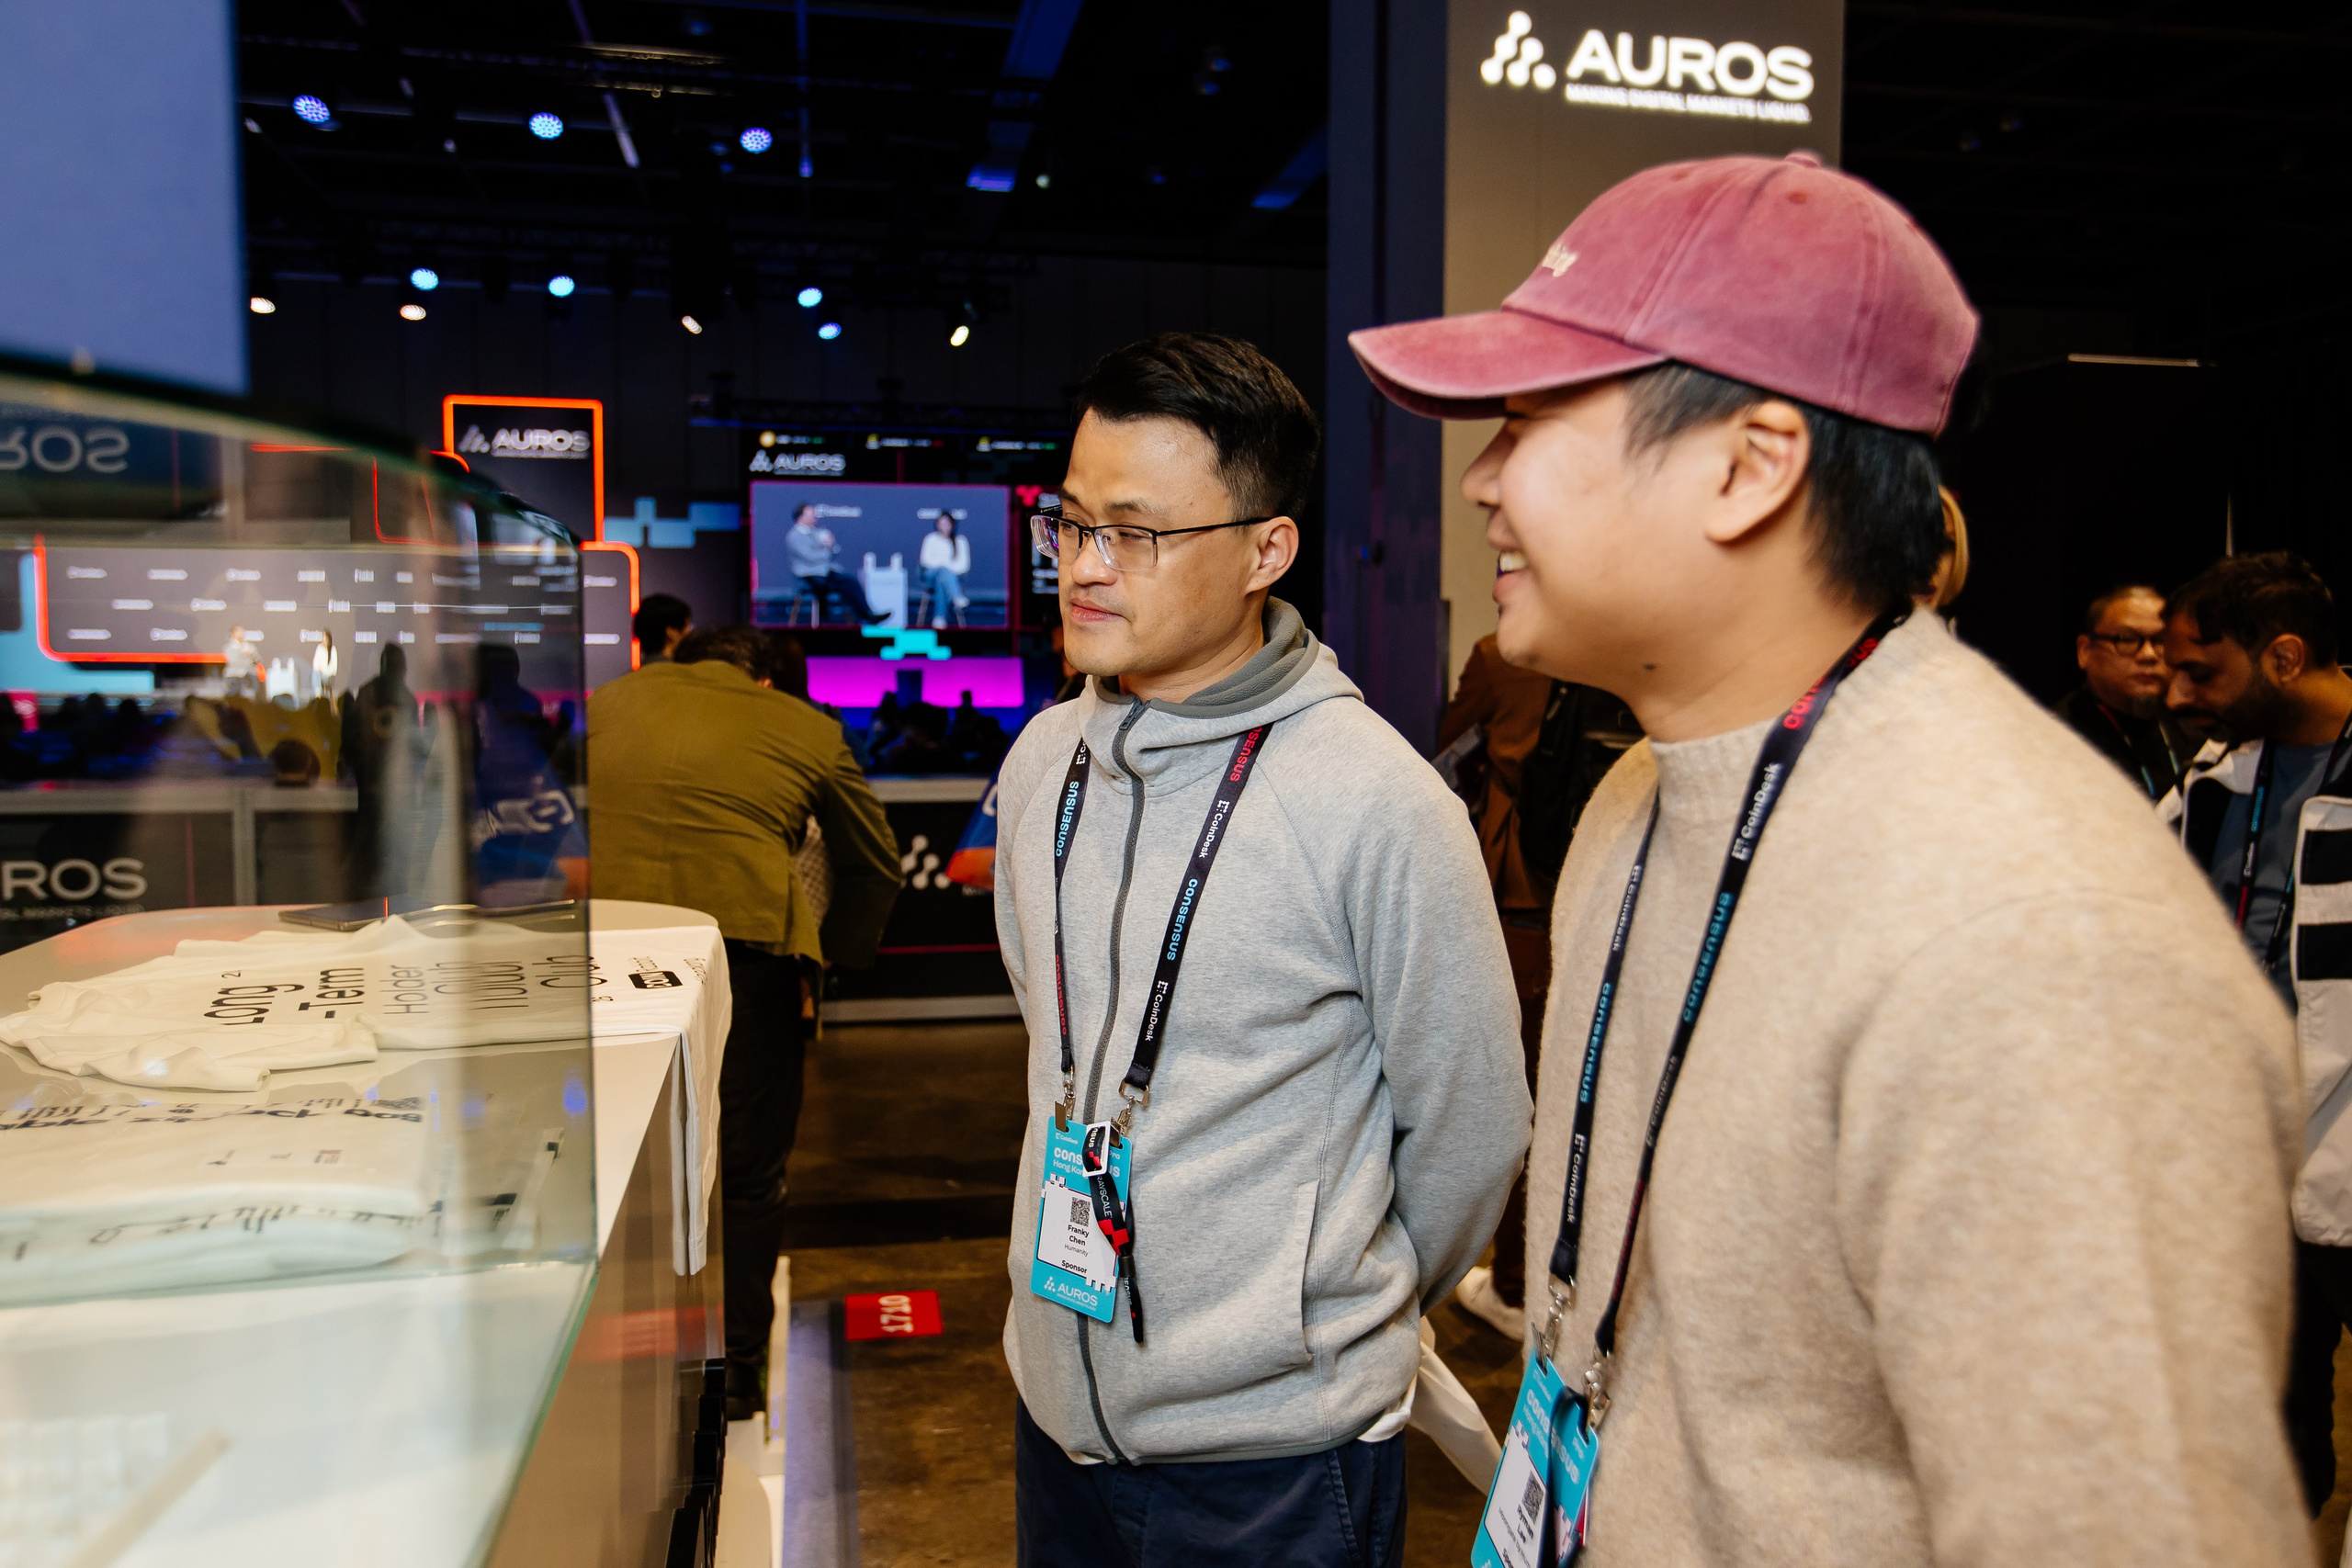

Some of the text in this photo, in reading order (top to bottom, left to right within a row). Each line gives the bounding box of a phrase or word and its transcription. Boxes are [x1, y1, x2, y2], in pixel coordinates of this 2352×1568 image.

[1566, 28, 1815, 101] AUROS
[492, 428, 591, 452] AUROS
[774, 453, 846, 471] AUROS
[1230, 727, 1263, 783] nSEnSUS
[1199, 812, 1223, 859] CoinDesk
[379, 964, 429, 1014] Holder
[203, 983, 305, 1026] Long
[1146, 994, 1163, 1042] CoinDesk
[1053, 1159, 1070, 1173] Hong
[1097, 1175, 1113, 1218] RAYSCALE
[1068, 1224, 1090, 1238] Franky
[1069, 1235, 1086, 1246] Chen
[1064, 1244, 1089, 1257] Humanity
[1061, 1259, 1088, 1274] Sponsor
[1057, 1282, 1098, 1306] AUROS
